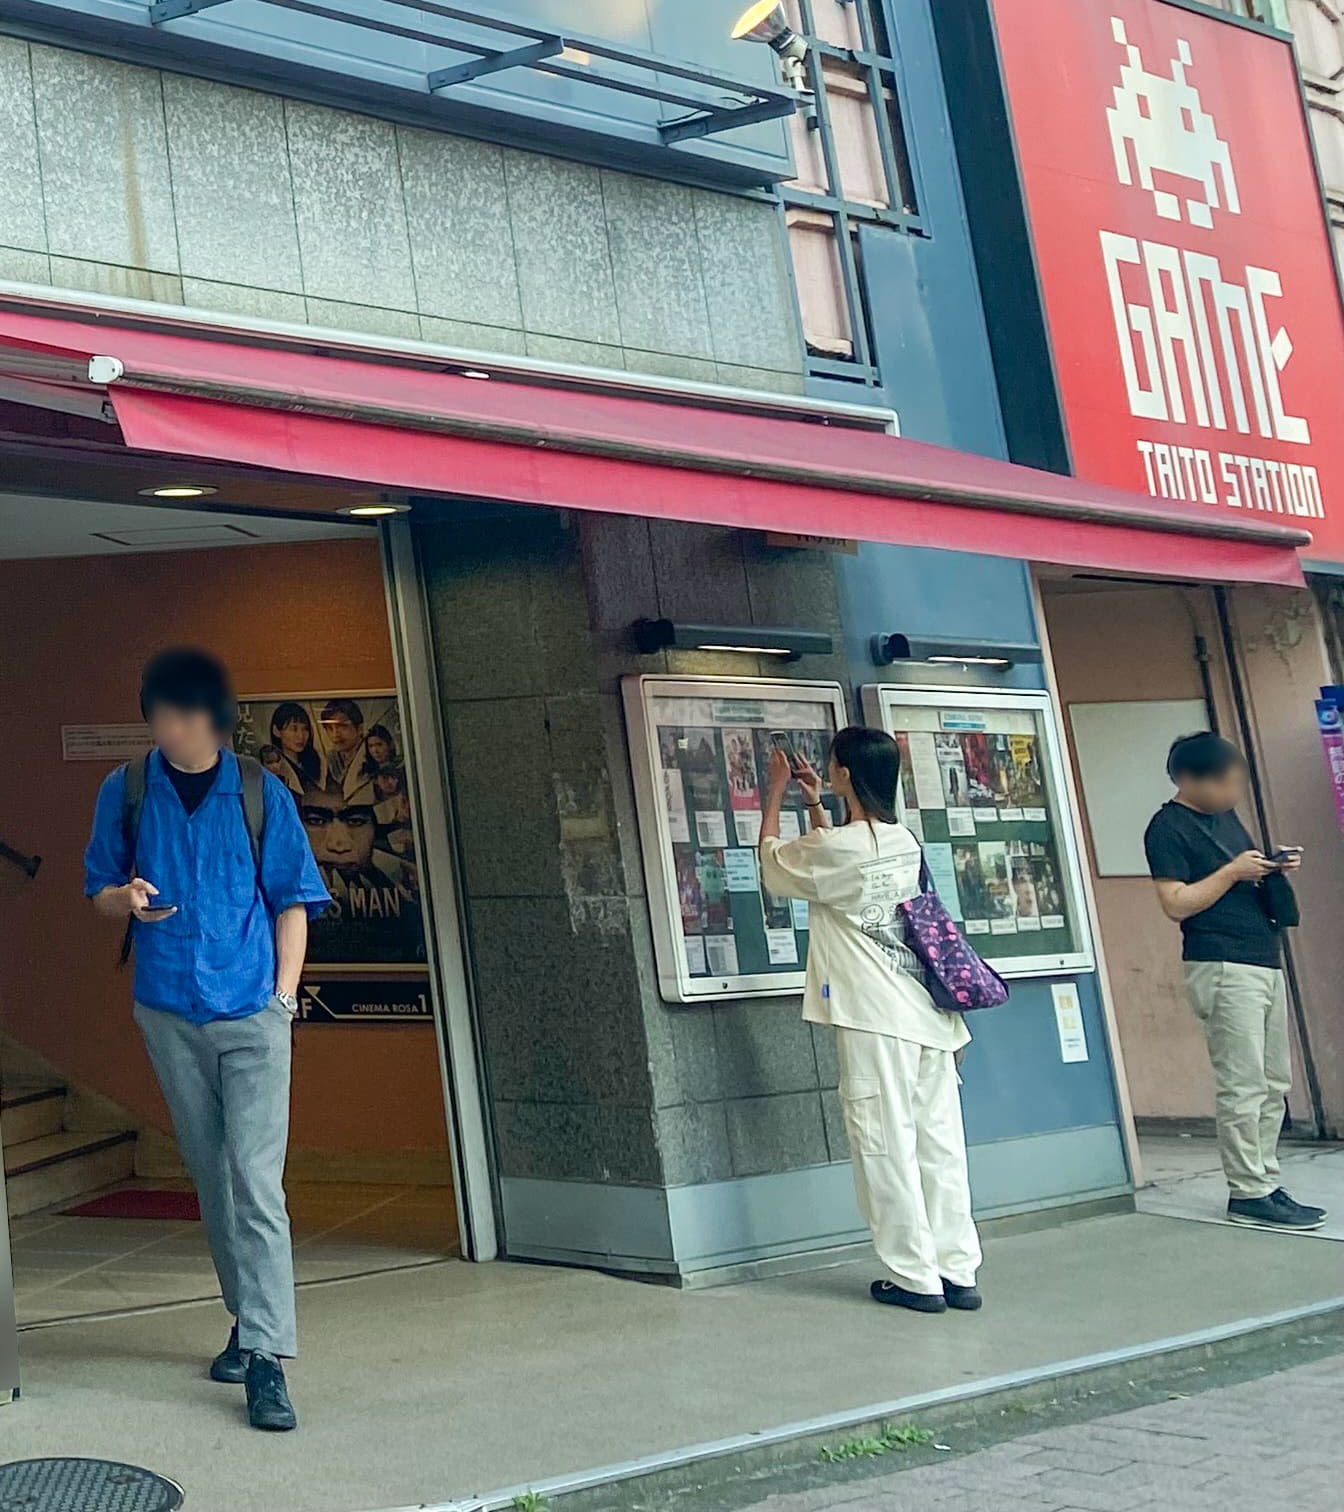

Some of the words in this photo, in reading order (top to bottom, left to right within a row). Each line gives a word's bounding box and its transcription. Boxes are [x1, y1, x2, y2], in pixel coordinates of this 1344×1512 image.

[1099, 229, 1311, 445] GAME
[1136, 439, 1219, 505] TAITO
[1217, 452, 1326, 520] STATION
[349, 887, 401, 919] MAN
[351, 1003, 390, 1013] CINEMA
[392, 1002, 419, 1013] ROSA
